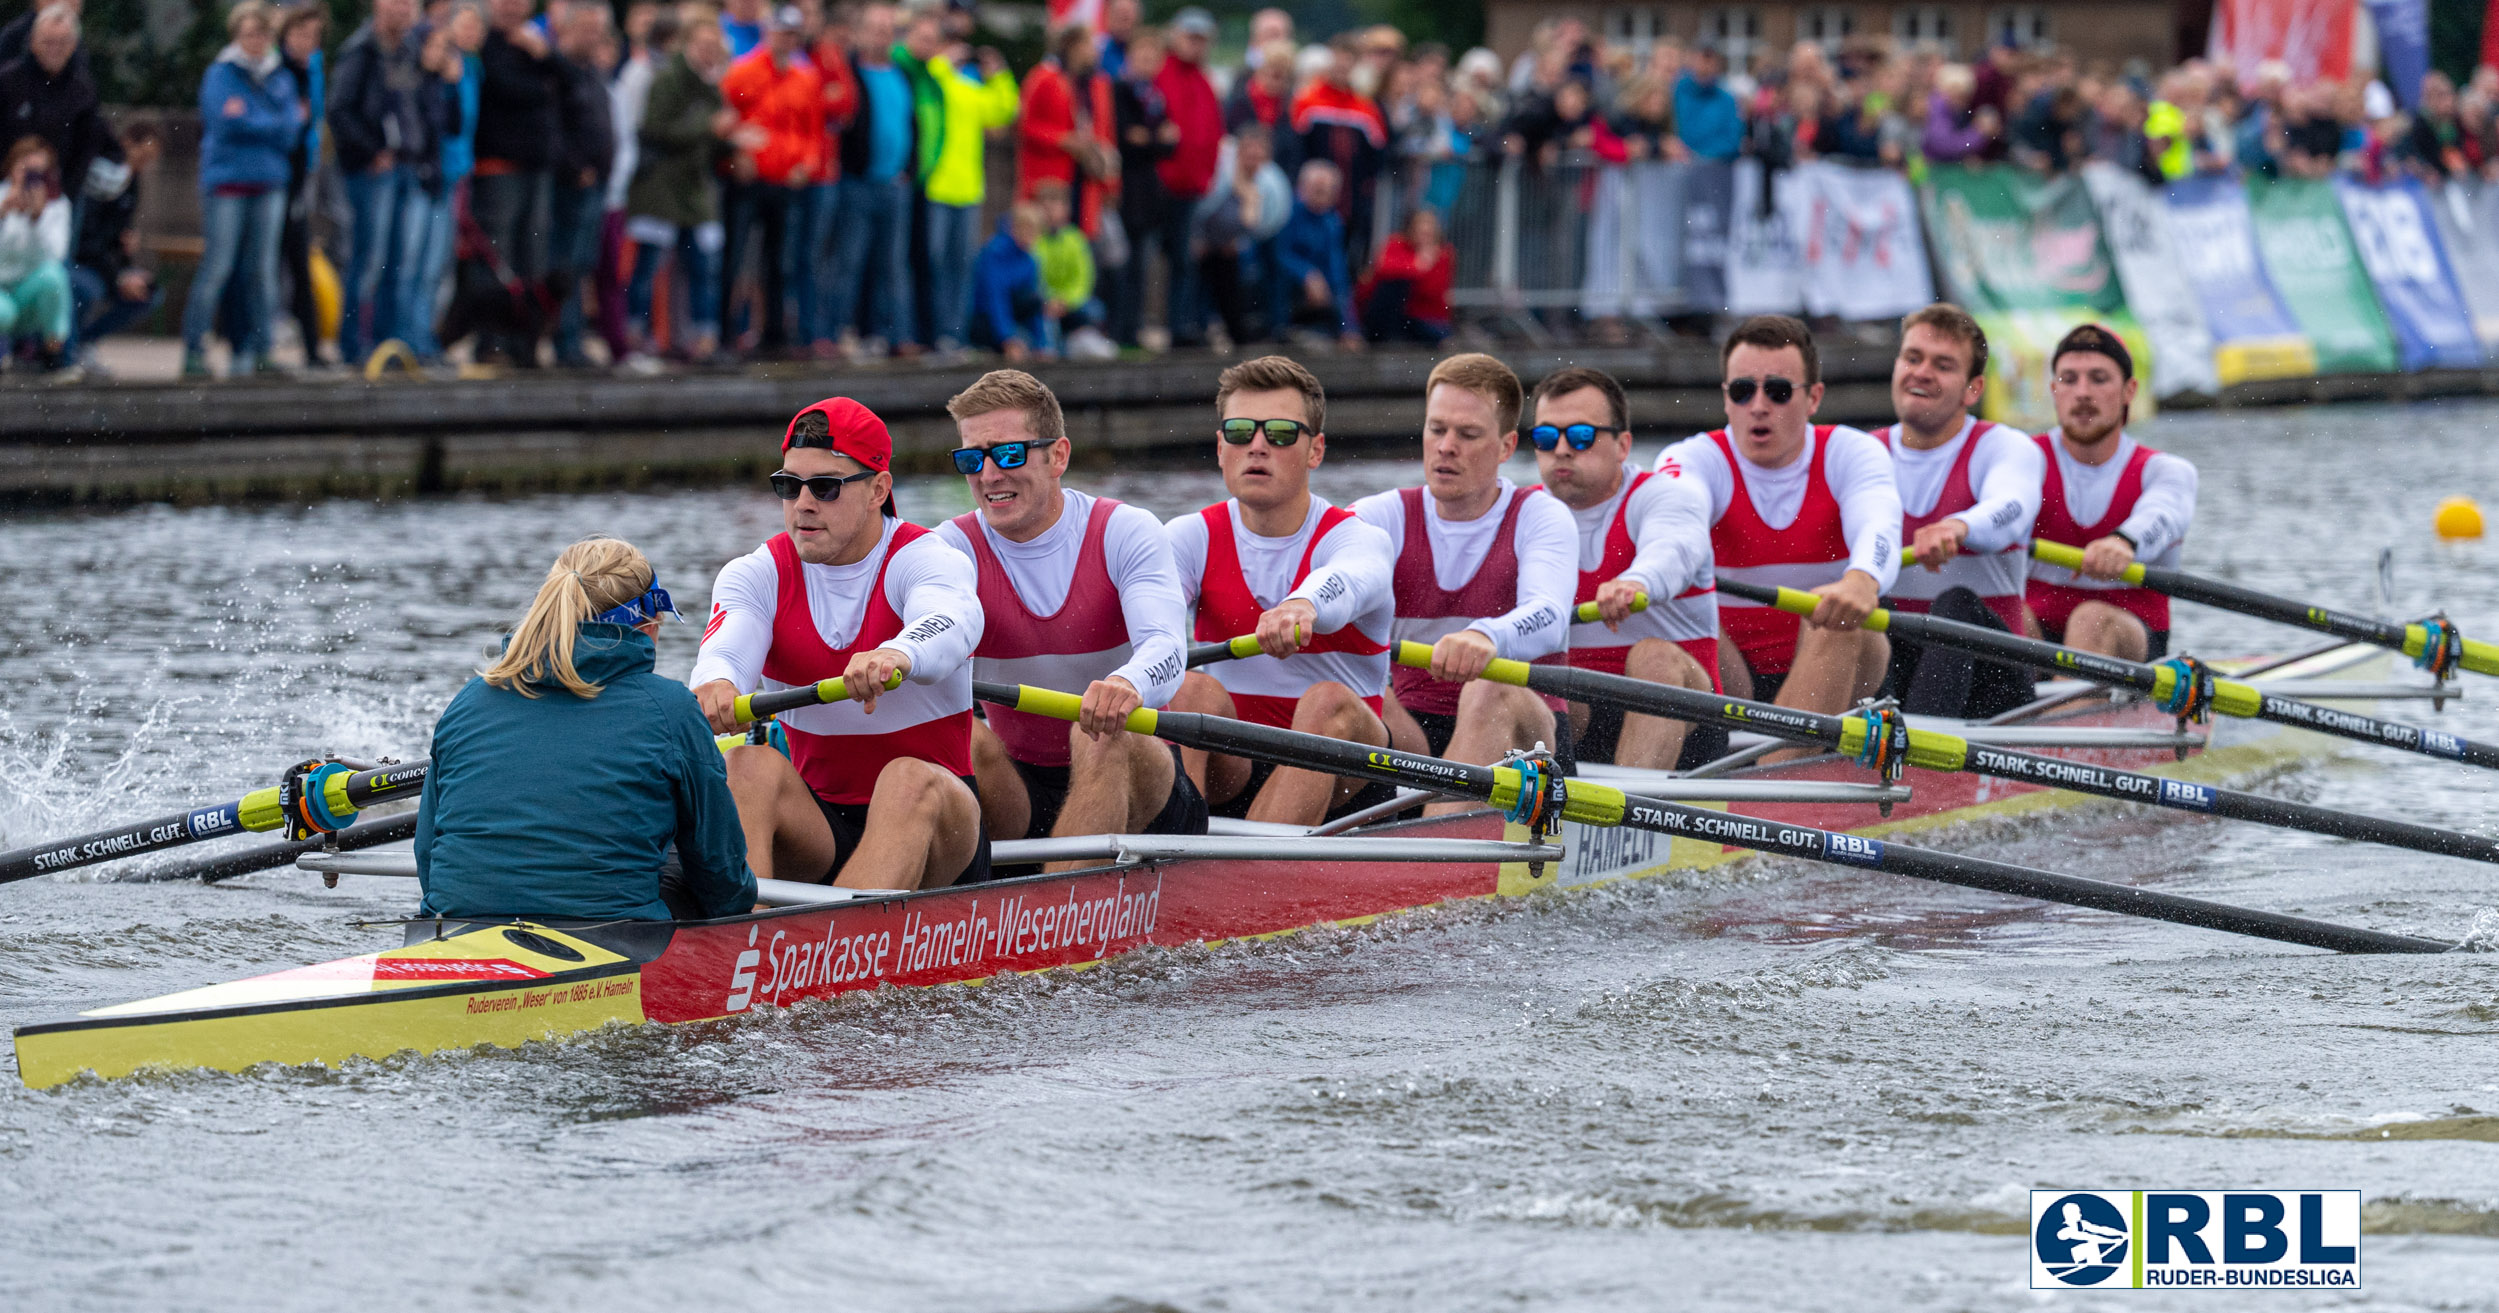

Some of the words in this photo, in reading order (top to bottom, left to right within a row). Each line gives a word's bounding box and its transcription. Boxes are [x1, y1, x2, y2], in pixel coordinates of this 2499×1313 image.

[903, 614, 955, 643] HAMELN
[1512, 607, 1557, 636] HAMELN
[1144, 648, 1182, 686] HAMELN
[1746, 708, 1806, 726] concept
[389, 766, 429, 783] conce
[1393, 758, 1455, 777] concept
[1459, 770, 1468, 779] 2
[1976, 750, 2032, 775] STARK.
[2034, 762, 2112, 789] SCHNELL.
[2115, 776, 2153, 795] GUT.
[2166, 782, 2209, 802] RBL
[193, 809, 232, 831] RBL
[1631, 806, 1690, 831] STARK.
[1693, 817, 1775, 843] SCHNELL.
[1778, 829, 1818, 849] GUT.
[34, 848, 84, 871] STARK.
[83, 834, 151, 860] SCHNELL.
[151, 823, 186, 844] GUT.
[1575, 822, 1655, 877] HAMELN
[1832, 835, 1876, 856] RBL
[760, 920, 890, 1005] Sparkasse
[896, 872, 1162, 973] Hameln-Weserbergland
[466, 993, 517, 1015] Ruderverein
[552, 993, 568, 1005] von
[570, 983, 588, 1001] 1885
[604, 977, 633, 998] Hameln
